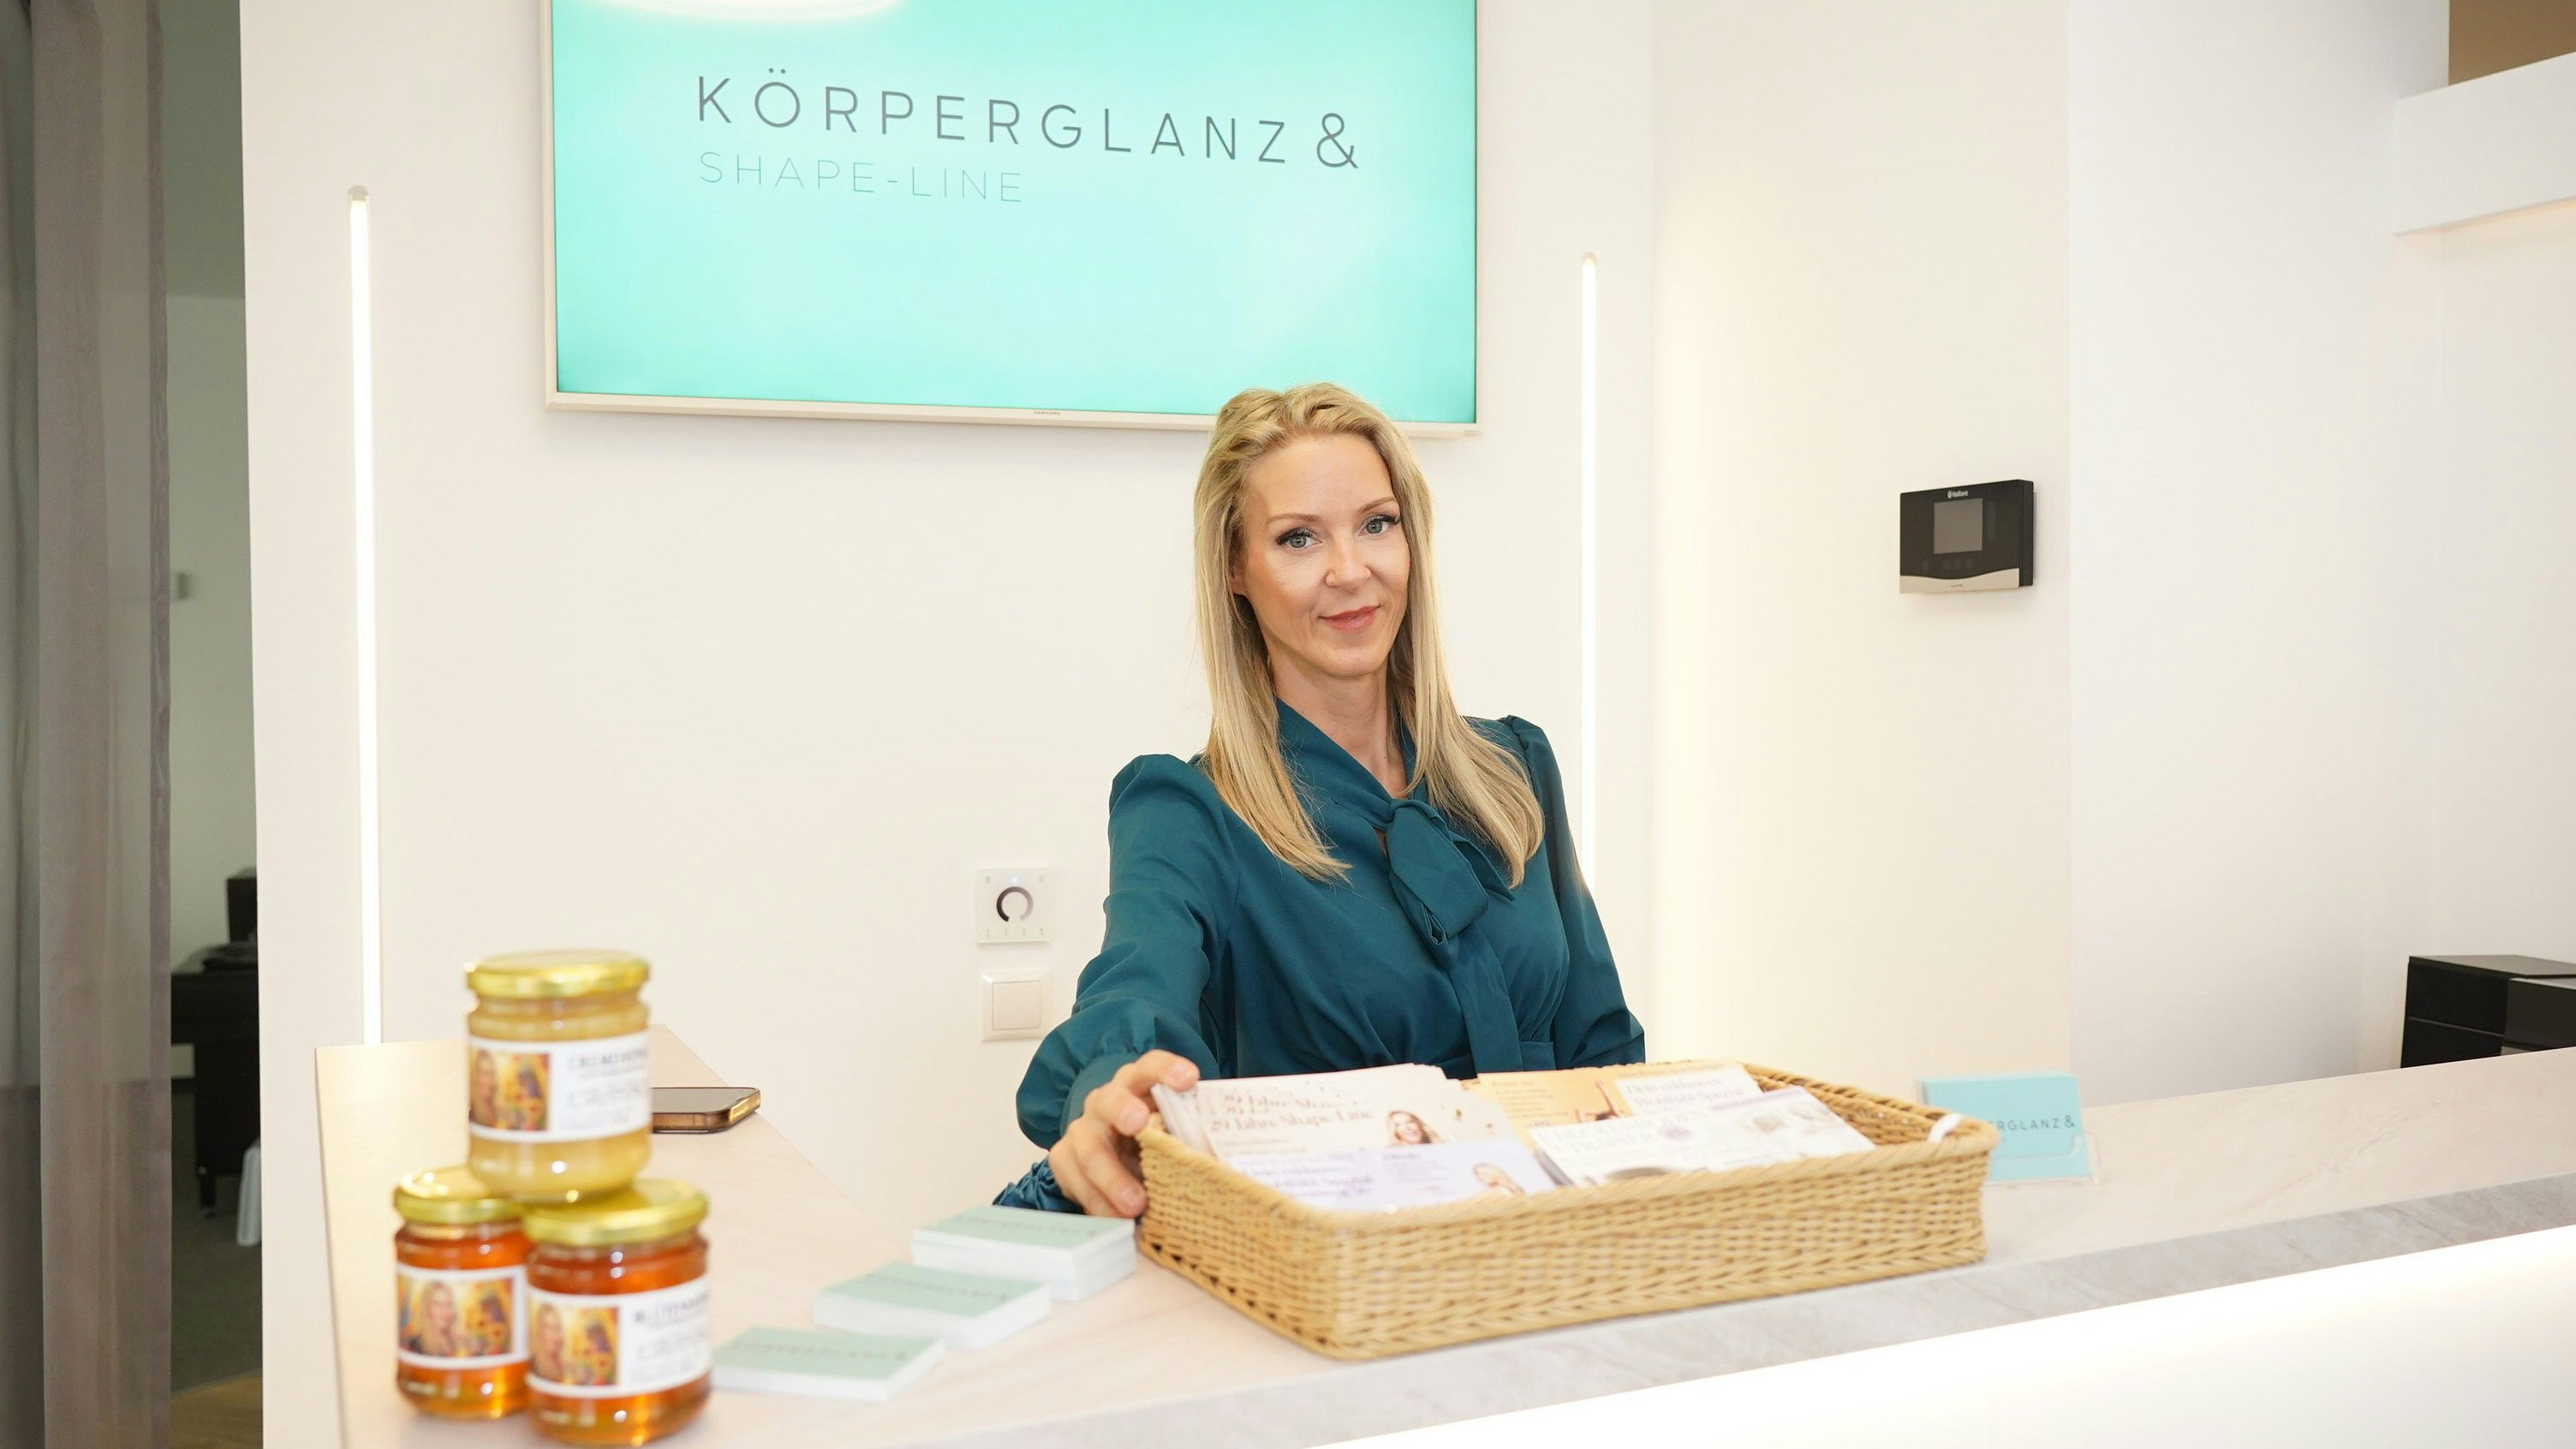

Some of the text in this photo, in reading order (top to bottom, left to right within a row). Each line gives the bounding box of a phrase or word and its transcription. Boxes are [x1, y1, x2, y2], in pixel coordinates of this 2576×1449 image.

[696, 67, 1360, 170] KÖRPERGLANZ &
[698, 151, 1023, 203] SHAPE-LINE
[1988, 1114, 2076, 1131] RGLANZ &
